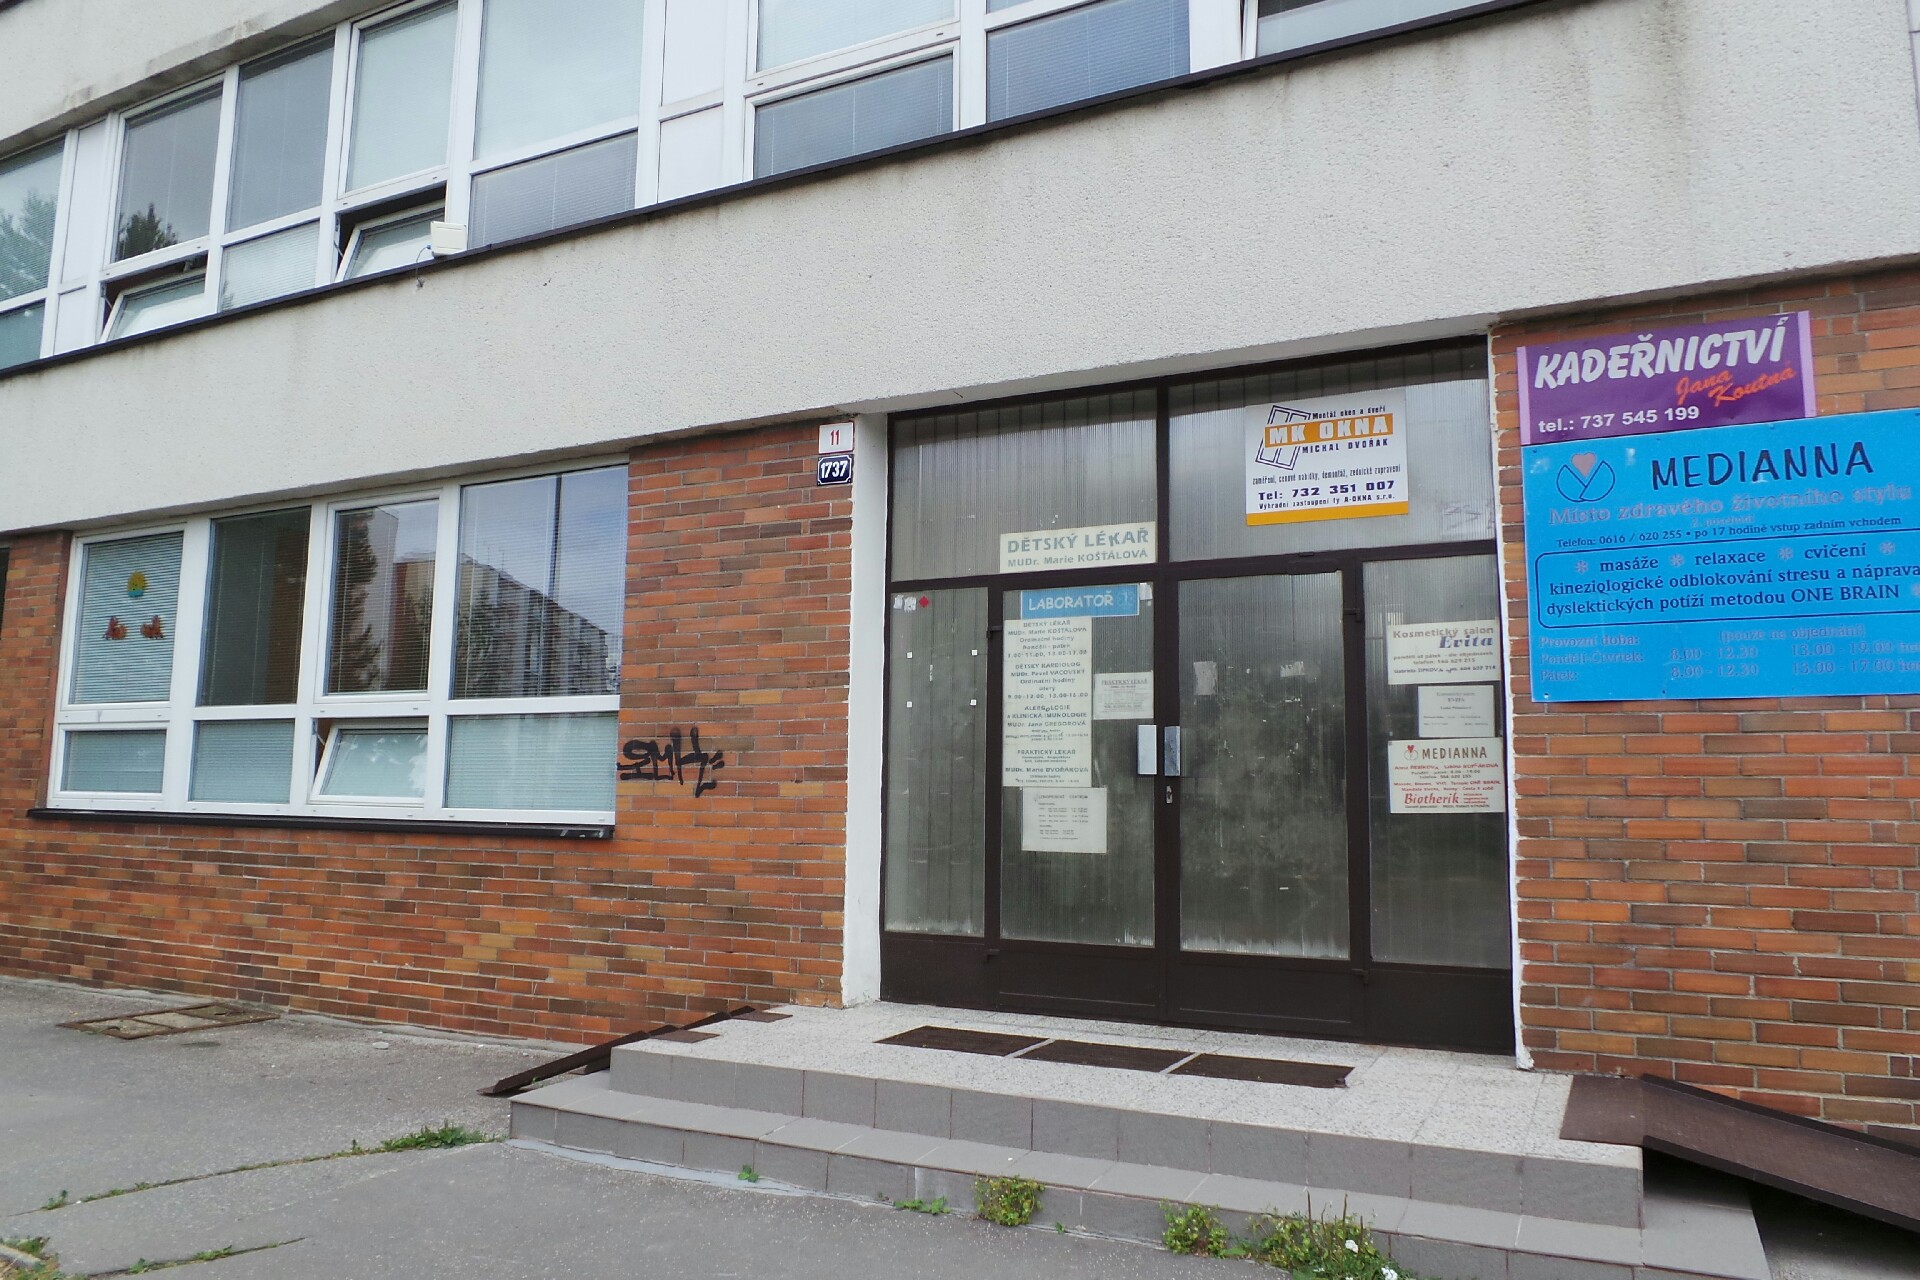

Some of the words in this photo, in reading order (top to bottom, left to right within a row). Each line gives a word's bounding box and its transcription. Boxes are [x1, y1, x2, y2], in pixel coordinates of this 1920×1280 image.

[1534, 316, 1788, 389] KADEŘNICTVÍ
[1676, 370, 1733, 405] Jana
[1340, 409, 1356, 417] oken
[1367, 405, 1386, 415] dveří
[1538, 418, 1574, 433] tel.:
[1580, 413, 1615, 429] 737
[1622, 409, 1658, 425] 545
[1664, 405, 1700, 422] 199
[830, 430, 839, 445] 11
[1269, 424, 1307, 445] MK
[1319, 415, 1389, 440] OKNA
[1302, 444, 1340, 454] MICHAL
[821, 461, 848, 478] 1737
[1651, 441, 1874, 491] MEDIANNA
[1258, 491, 1283, 501] Tel:
[1292, 487, 1320, 498] 732
[1329, 483, 1357, 495] 351
[1365, 480, 1395, 492] 007
[1292, 498, 1329, 508] zastoupení
[1343, 494, 1372, 503] A-OKNA
[1549, 507, 1611, 525] Místo
[1618, 498, 1723, 521] zdravého
[1732, 487, 1844, 511] životního
[1853, 483, 1911, 505] stylu
[1007, 533, 1078, 553] DĚTSKÝ
[1084, 527, 1149, 548] LÉKAŘ
[1556, 537, 1596, 548] Telefon:
[1600, 535, 1625, 544] 0616
[1639, 532, 1658, 541] 620
[1662, 530, 1682, 540] 255
[1694, 529, 1708, 540] po
[1713, 527, 1725, 537] 17
[1771, 523, 1800, 534] vstup
[1804, 520, 1845, 531] zadním
[1850, 517, 1902, 527] vchodem
[1007, 558, 1040, 568] MUDr.
[1043, 556, 1074, 565] Marie
[1600, 555, 1659, 572] masáže
[1695, 551, 1766, 566] relaxace
[1804, 543, 1867, 560] cvičení
[1550, 575, 1663, 597] kineziologické
[1669, 569, 1773, 588] odblokování
[1778, 568, 1830, 582] stresu
[1837, 568, 1846, 579] a
[1852, 564, 1920, 581] náprava
[1028, 590, 1114, 611] LABORATOŘ
[1547, 597, 1654, 618] dyslektických
[1660, 593, 1704, 612] potíží
[1711, 591, 1785, 606] metodou
[1791, 587, 1834, 603] ONE
[1840, 584, 1899, 601] BRAIN
[1393, 627, 1459, 639] Kosmetický
[1464, 626, 1494, 635] salon
[1439, 634, 1494, 649] Evita
[1670, 648, 1702, 662] 8.00
[1717, 646, 1758, 660] 12.30
[1791, 643, 1833, 657] 13.00
[1851, 641, 1894, 655] 19.00
[1671, 666, 1703, 679] 8.00
[1717, 664, 1758, 677] 12.30
[1792, 661, 1834, 675] 13.00
[1852, 659, 1894, 673] 17.00
[1422, 746, 1487, 759] MEDIANNA
[1404, 792, 1459, 805] Biotherik
